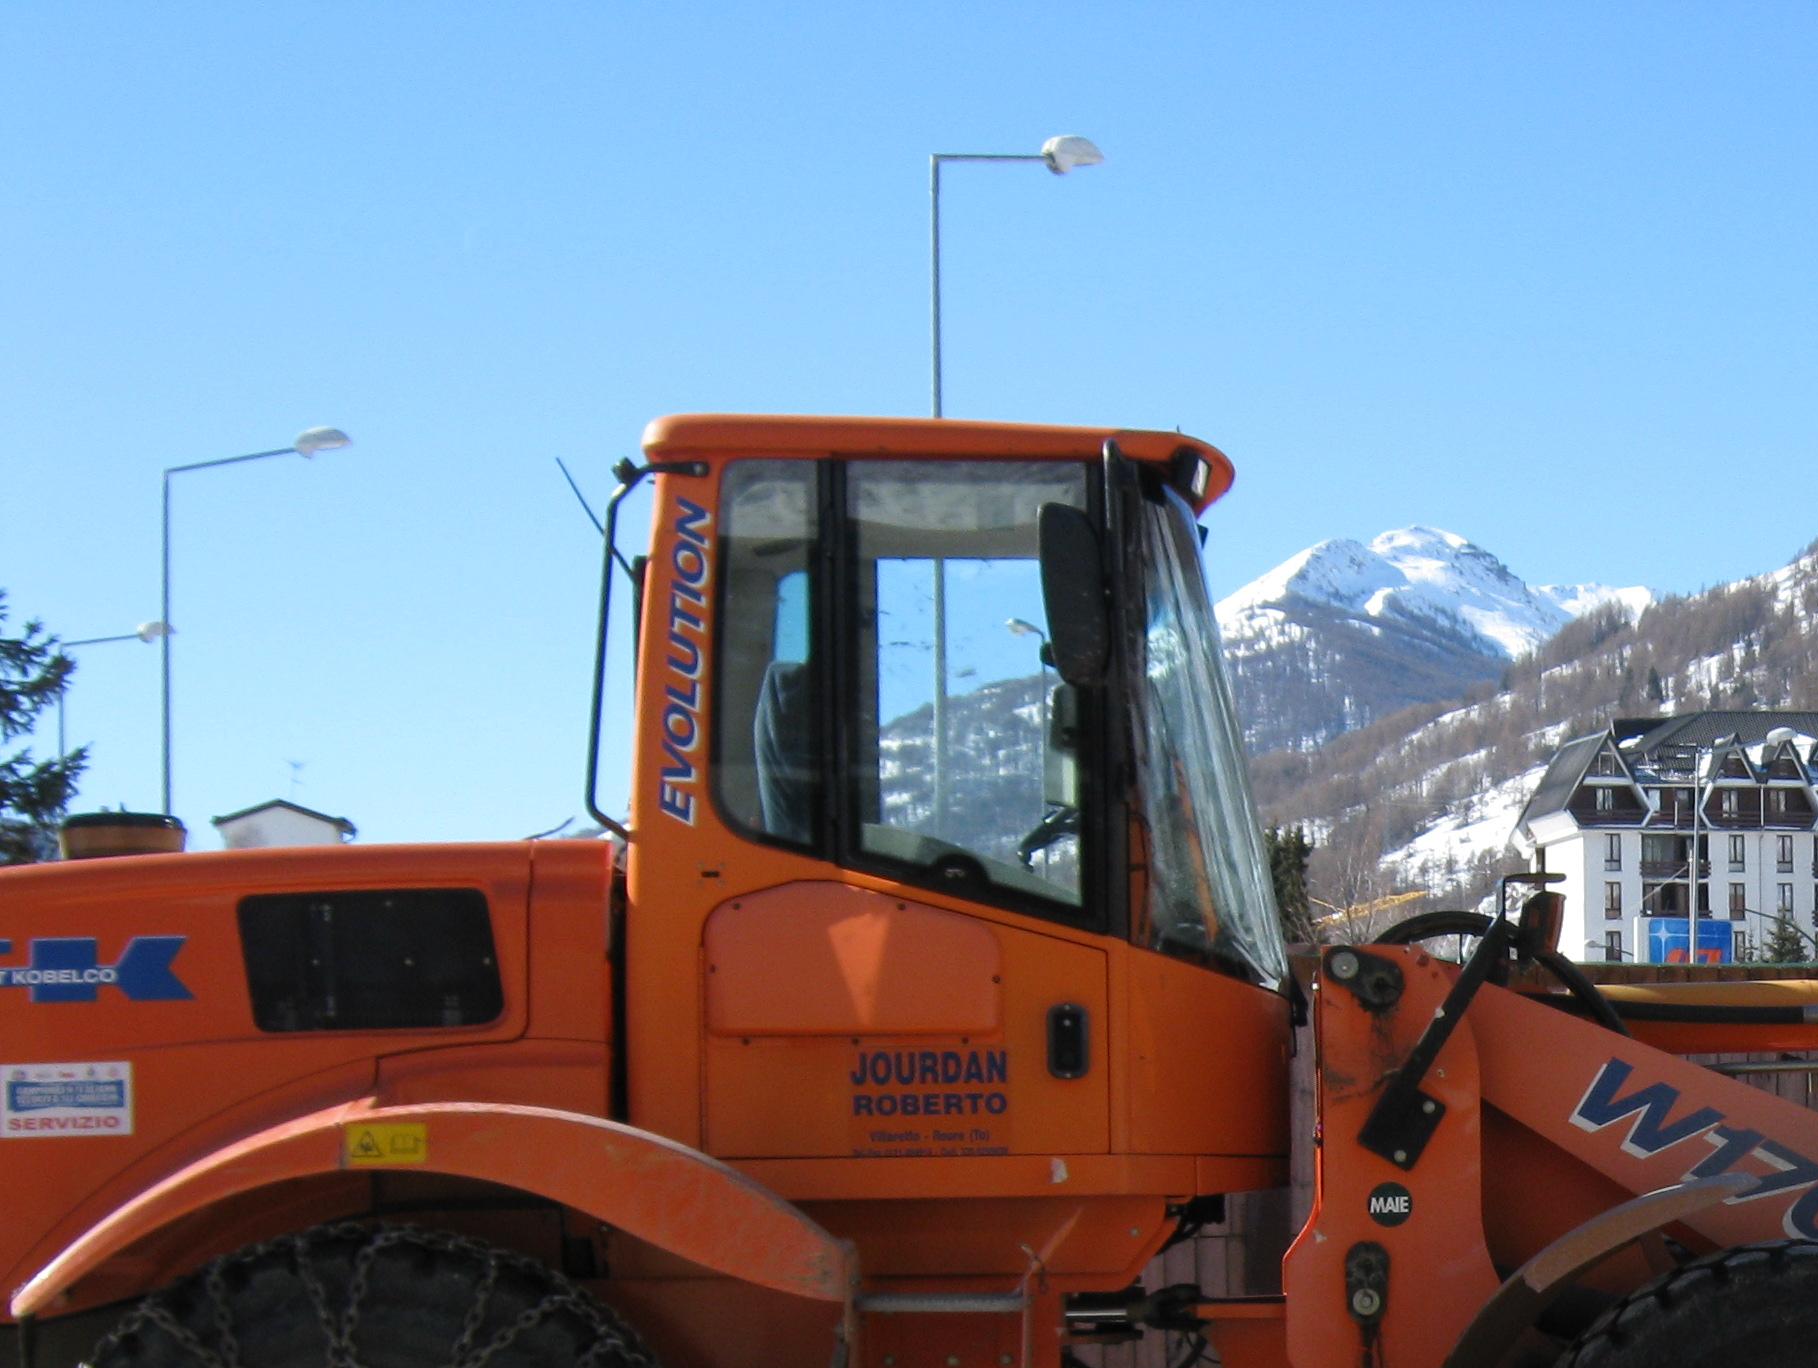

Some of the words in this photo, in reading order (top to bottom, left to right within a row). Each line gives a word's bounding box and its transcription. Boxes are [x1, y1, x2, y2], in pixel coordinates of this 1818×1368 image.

[659, 496, 711, 827] EVOLUTION
[12, 968, 118, 985] KOBELCO
[851, 1050, 1008, 1086] JOURDAN
[853, 1092, 1008, 1117] ROBERTO
[7, 1115, 121, 1132] SERVIZIO
[1370, 1195, 1410, 1214] MAIE
